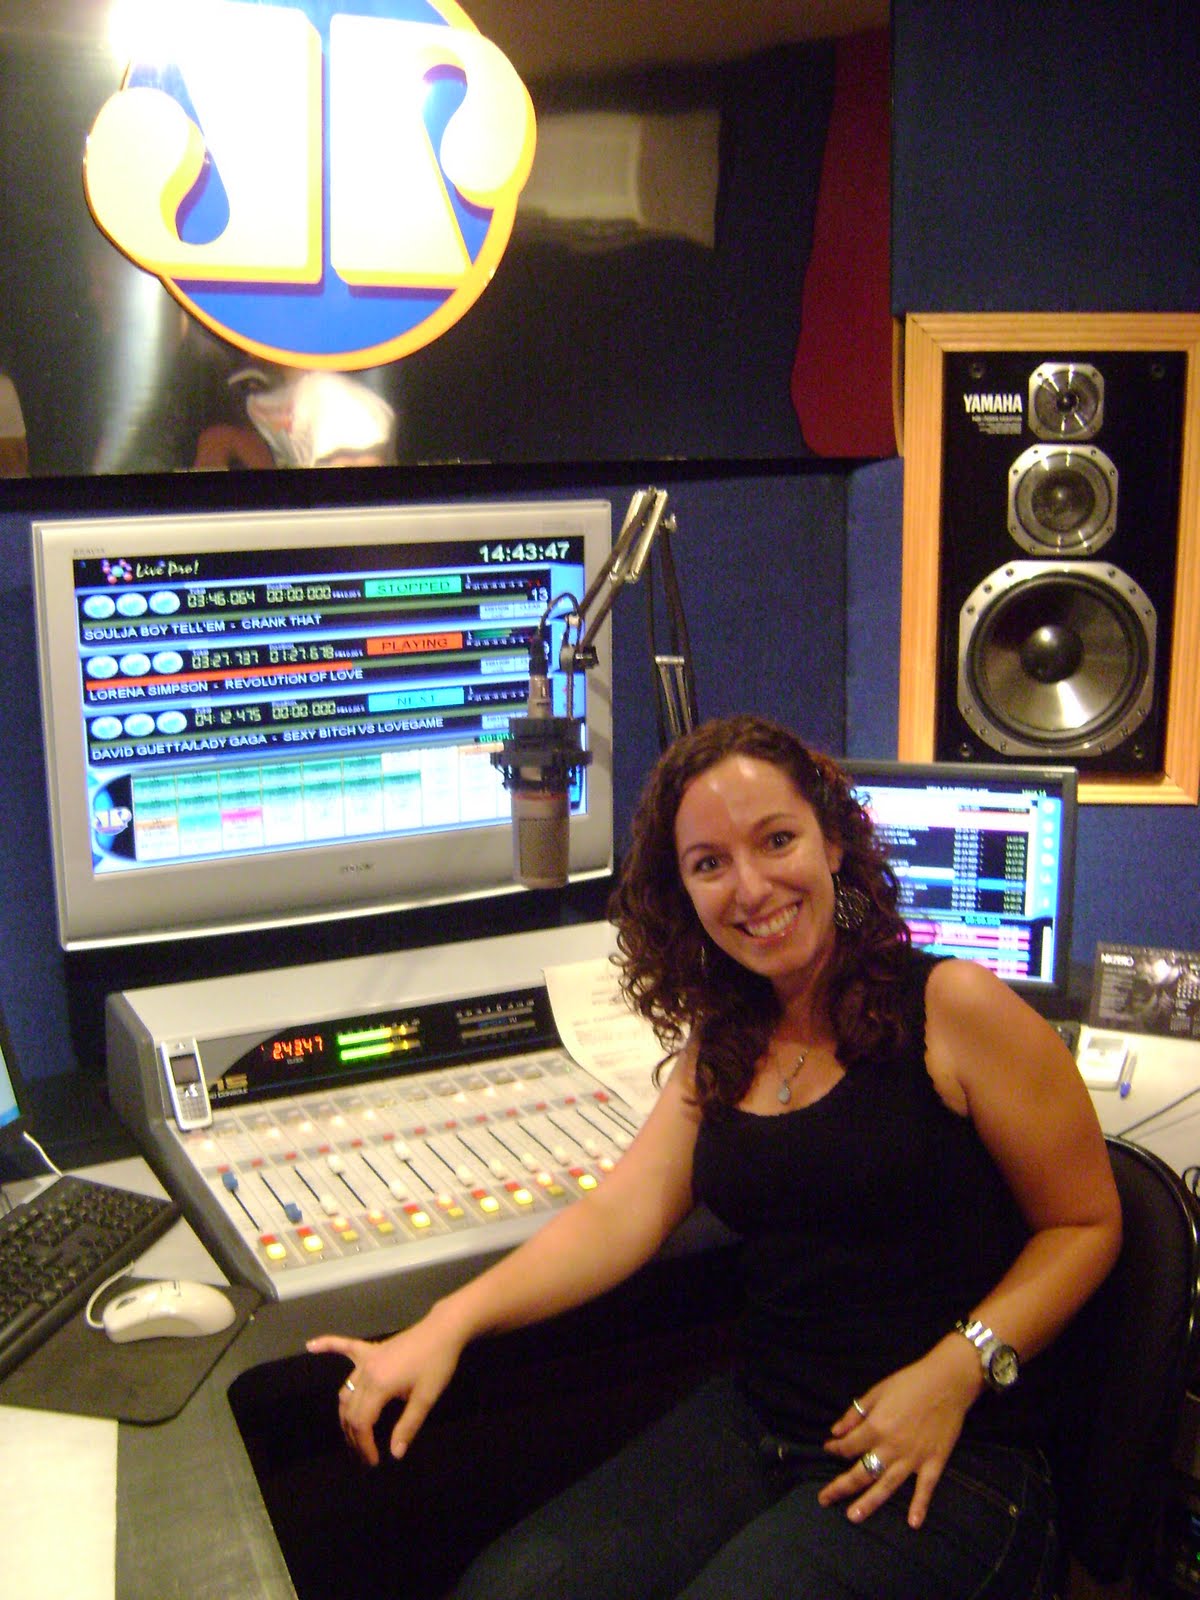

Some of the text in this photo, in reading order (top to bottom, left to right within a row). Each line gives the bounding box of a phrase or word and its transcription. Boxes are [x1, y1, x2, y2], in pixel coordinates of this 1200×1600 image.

[963, 393, 1023, 413] YAMAHA
[479, 541, 570, 562] 14:43:47
[136, 560, 199, 578] Live Pro!
[377, 580, 451, 595] STOPPED
[84, 625, 138, 641] SOULJA
[141, 622, 169, 638] BOY
[171, 620, 226, 636] TELL'EM
[242, 615, 287, 629] CRANK
[290, 613, 322, 626] THAT
[382, 637, 448, 651] PLAYING
[89, 686, 146, 701] LORENA
[148, 681, 209, 697] SIMPSON
[225, 673, 308, 690] REVOLUTION
[310, 672, 328, 684] OF
[331, 669, 364, 682] LOVE
[92, 744, 134, 760] DAVID
[137, 737, 228, 756] GUETTA/LADY
[229, 733, 268, 748] GAGA
[283, 728, 316, 742] SEXY
[319, 724, 356, 739] BITCH
[359, 723, 375, 736] VS
[378, 717, 444, 734] LOVEGAME
